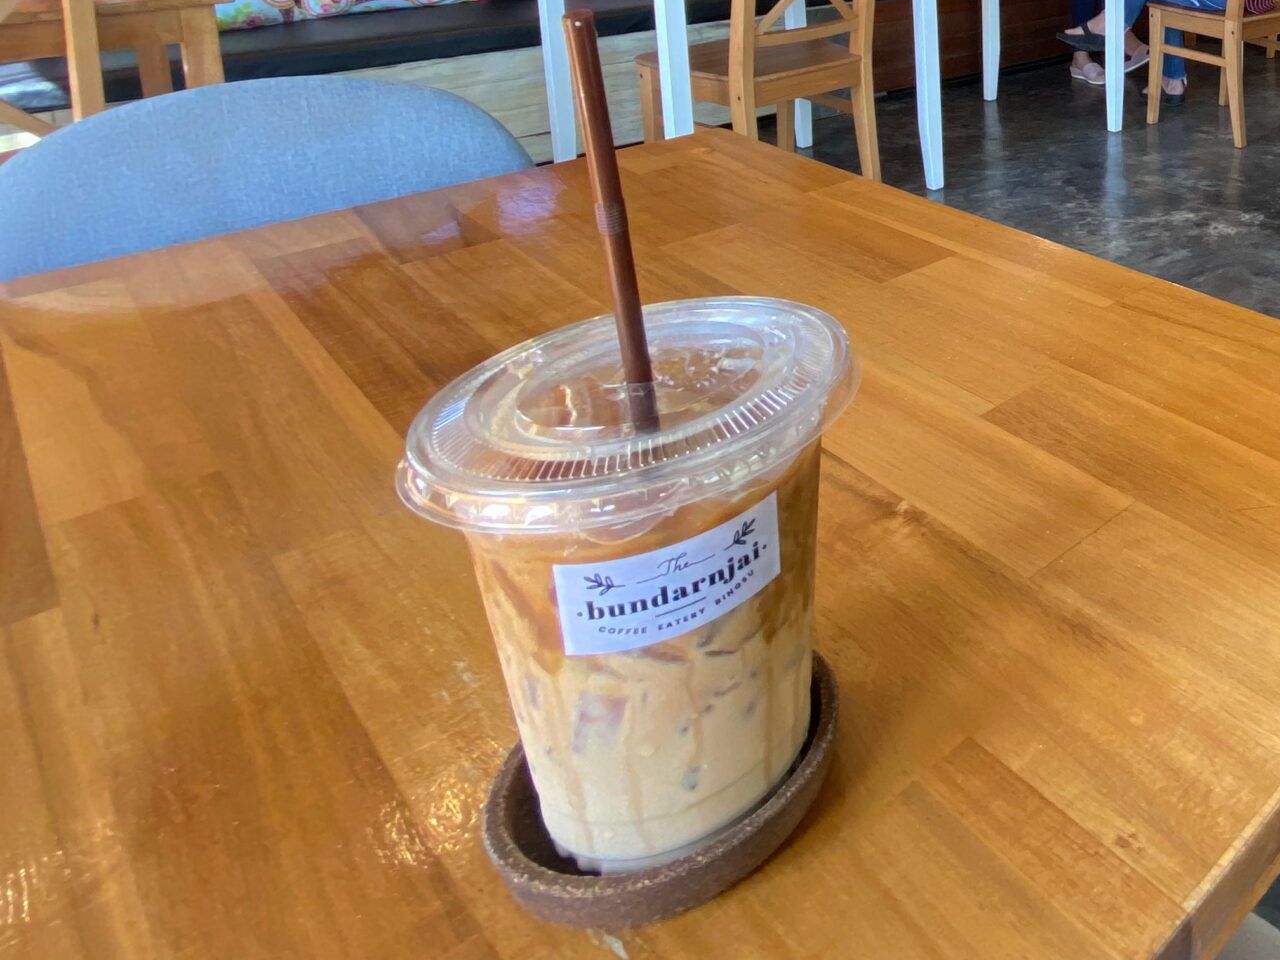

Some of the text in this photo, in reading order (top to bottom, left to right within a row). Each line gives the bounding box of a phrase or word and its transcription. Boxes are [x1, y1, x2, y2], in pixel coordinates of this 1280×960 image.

[650, 552, 699, 578] The
[586, 541, 761, 620] bundarnjai
[598, 626, 648, 635] COFFEE
[657, 607, 706, 631] EATERY
